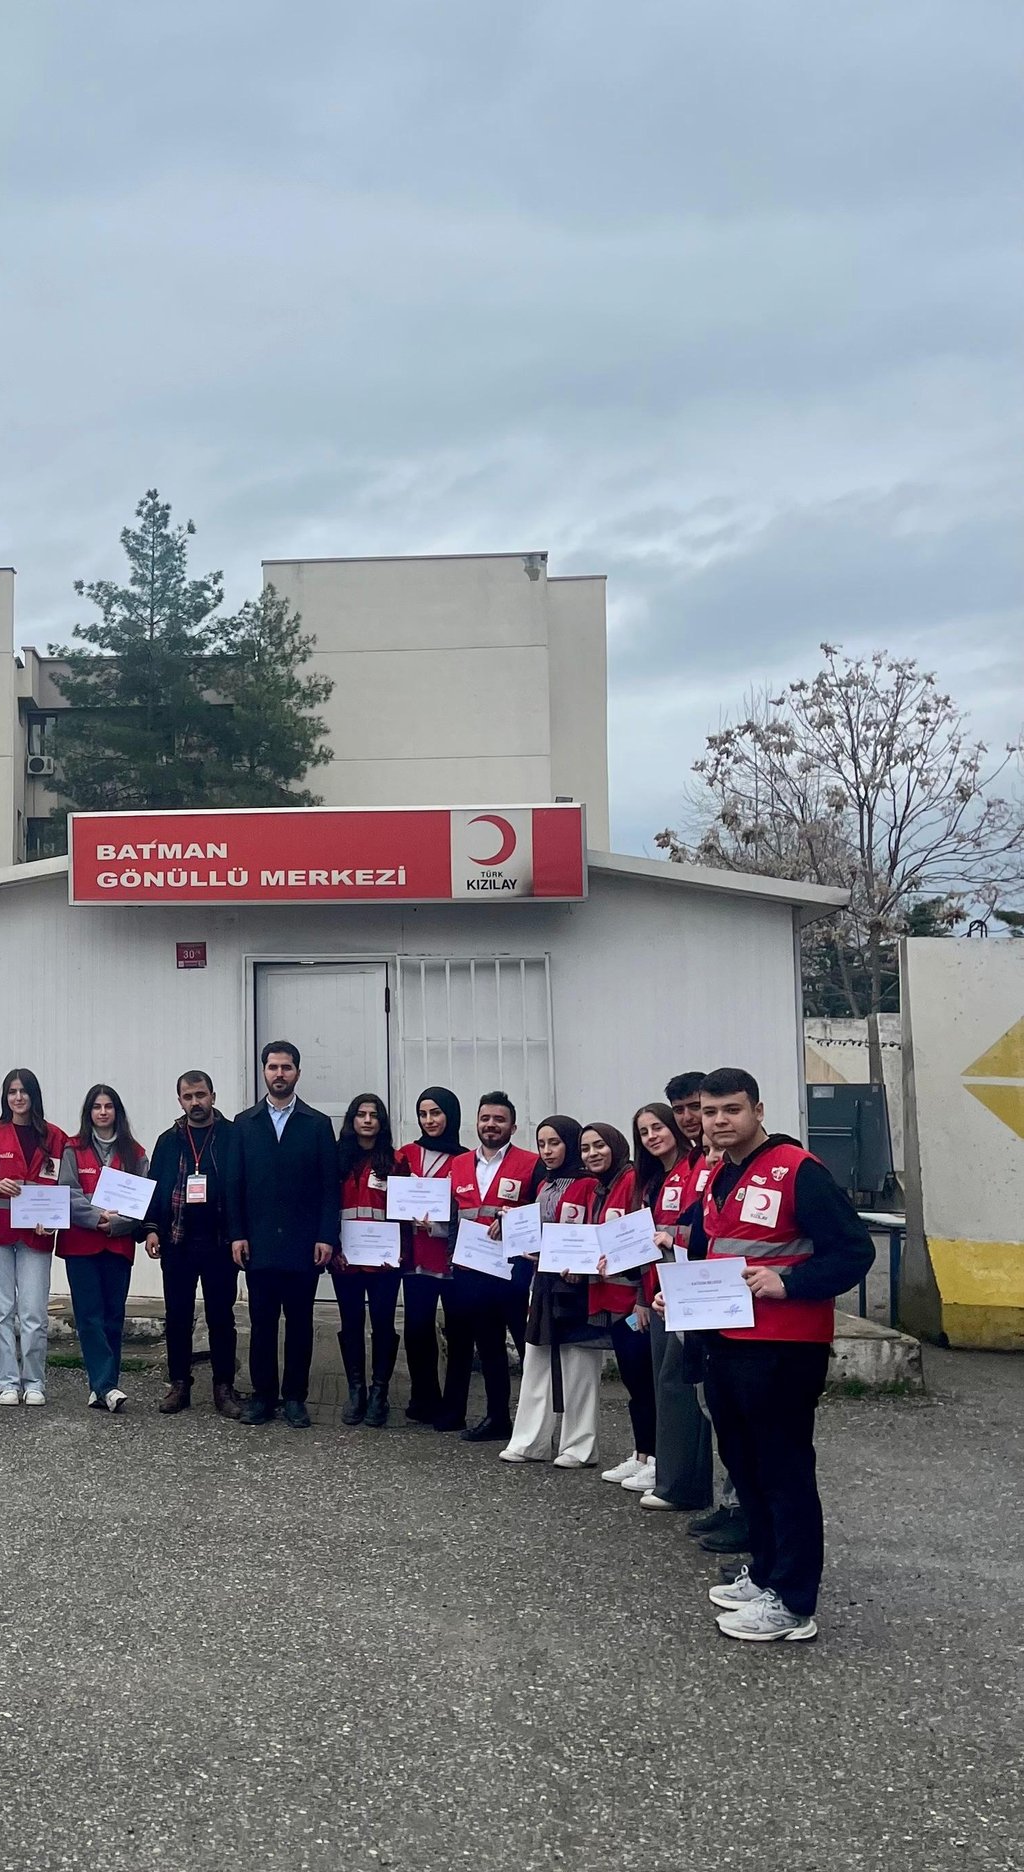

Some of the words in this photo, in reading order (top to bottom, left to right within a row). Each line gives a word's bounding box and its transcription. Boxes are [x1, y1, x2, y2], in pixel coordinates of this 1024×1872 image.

[96, 843, 228, 860] BATMAN
[96, 867, 249, 888] GÖNÜLLÜ
[260, 865, 406, 886] MERKEZİ
[480, 870, 504, 878] TÜRK
[466, 879, 518, 890] KIZILAY
